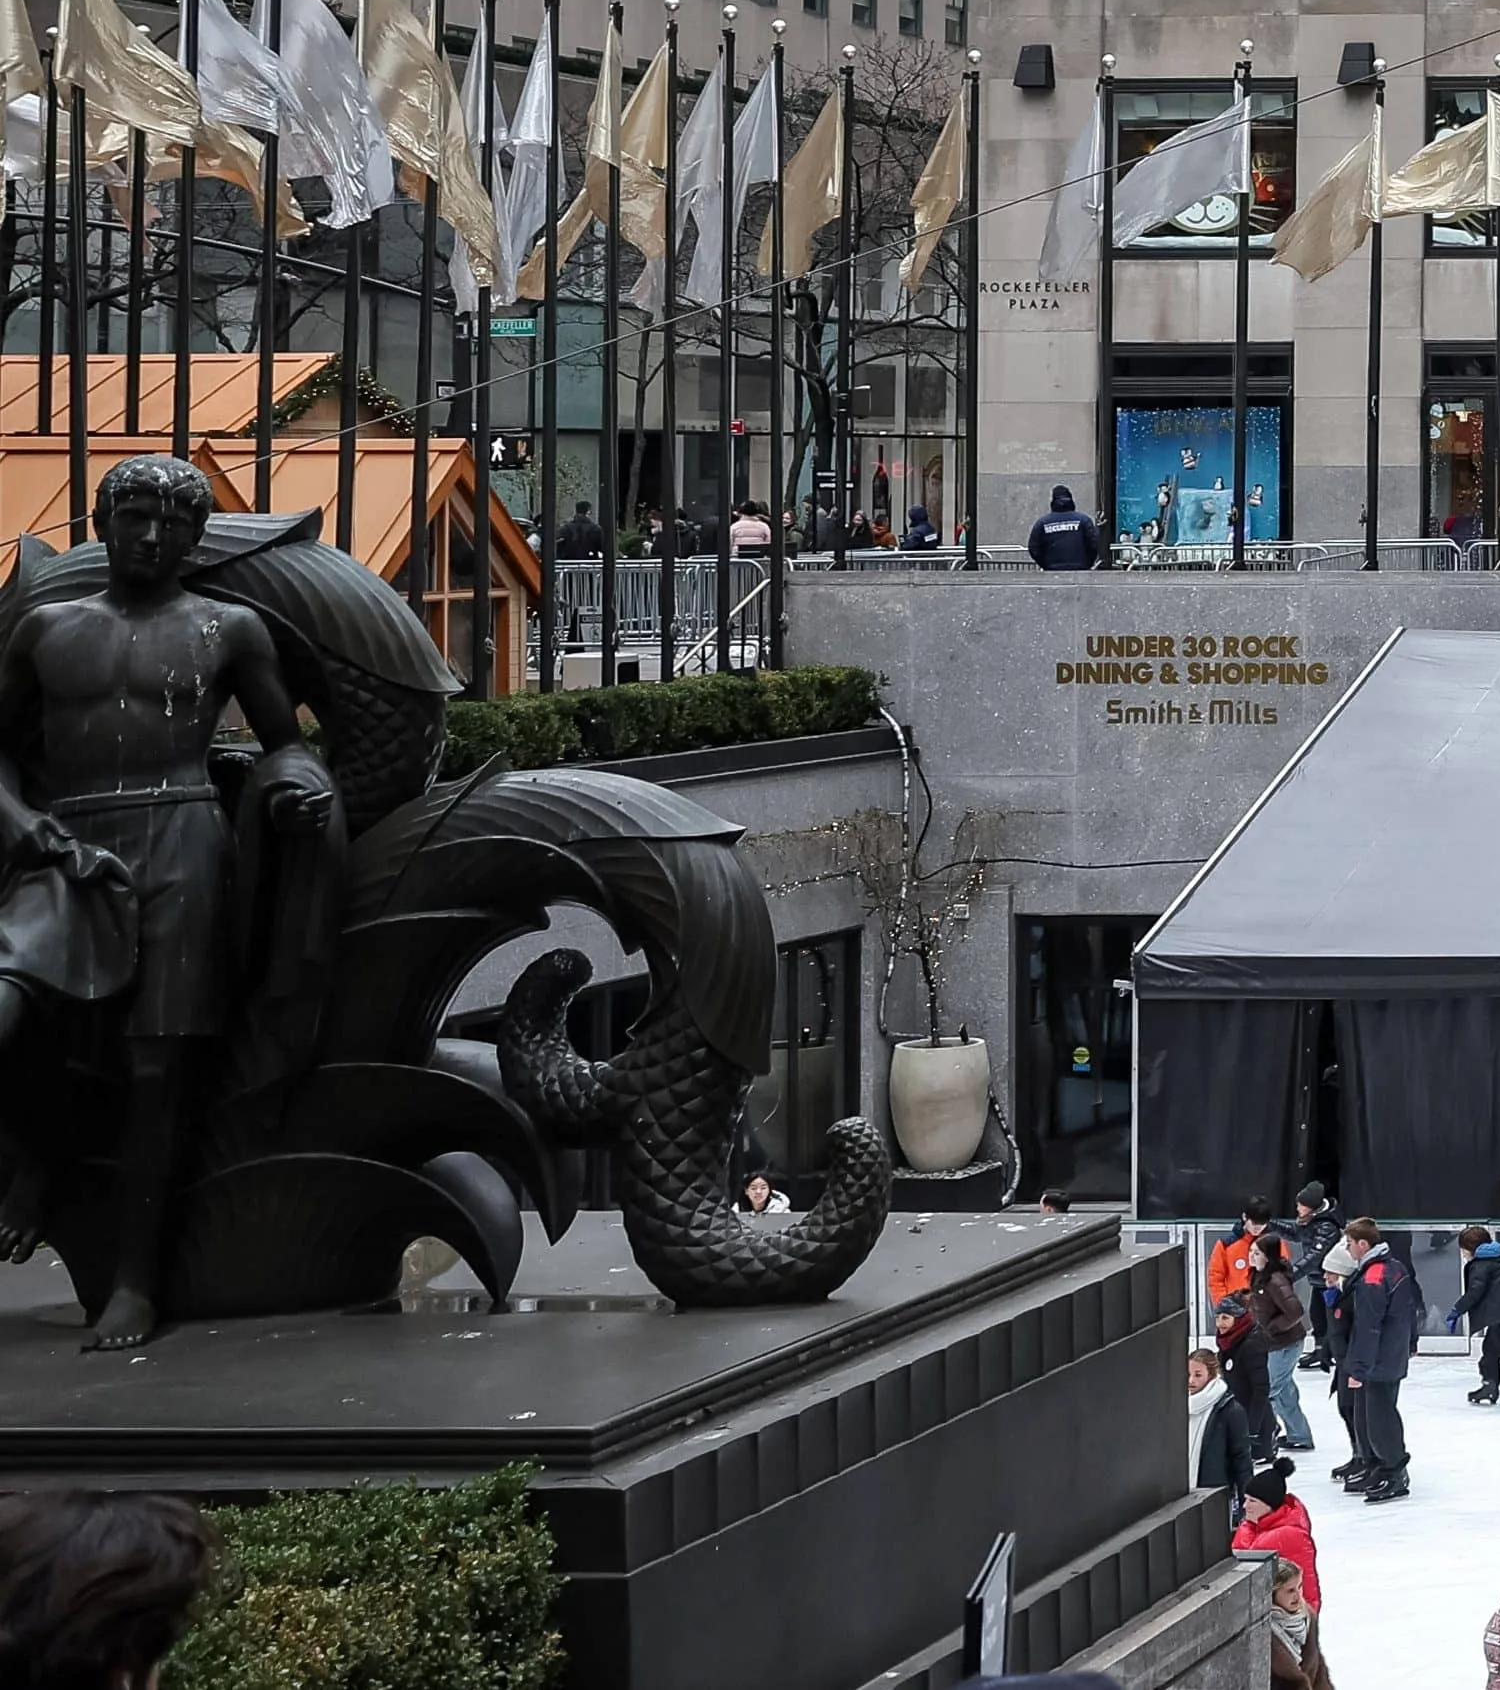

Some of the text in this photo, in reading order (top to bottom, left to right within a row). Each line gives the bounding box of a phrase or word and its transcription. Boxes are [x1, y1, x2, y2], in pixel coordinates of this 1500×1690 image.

[1009, 298, 1060, 309] PLAZA
[1086, 635, 1299, 658] UNDER 30 ROCK
[1056, 662, 1329, 685] DINING & SHOPPING
[1106, 699, 1278, 725] Smith & Mills
